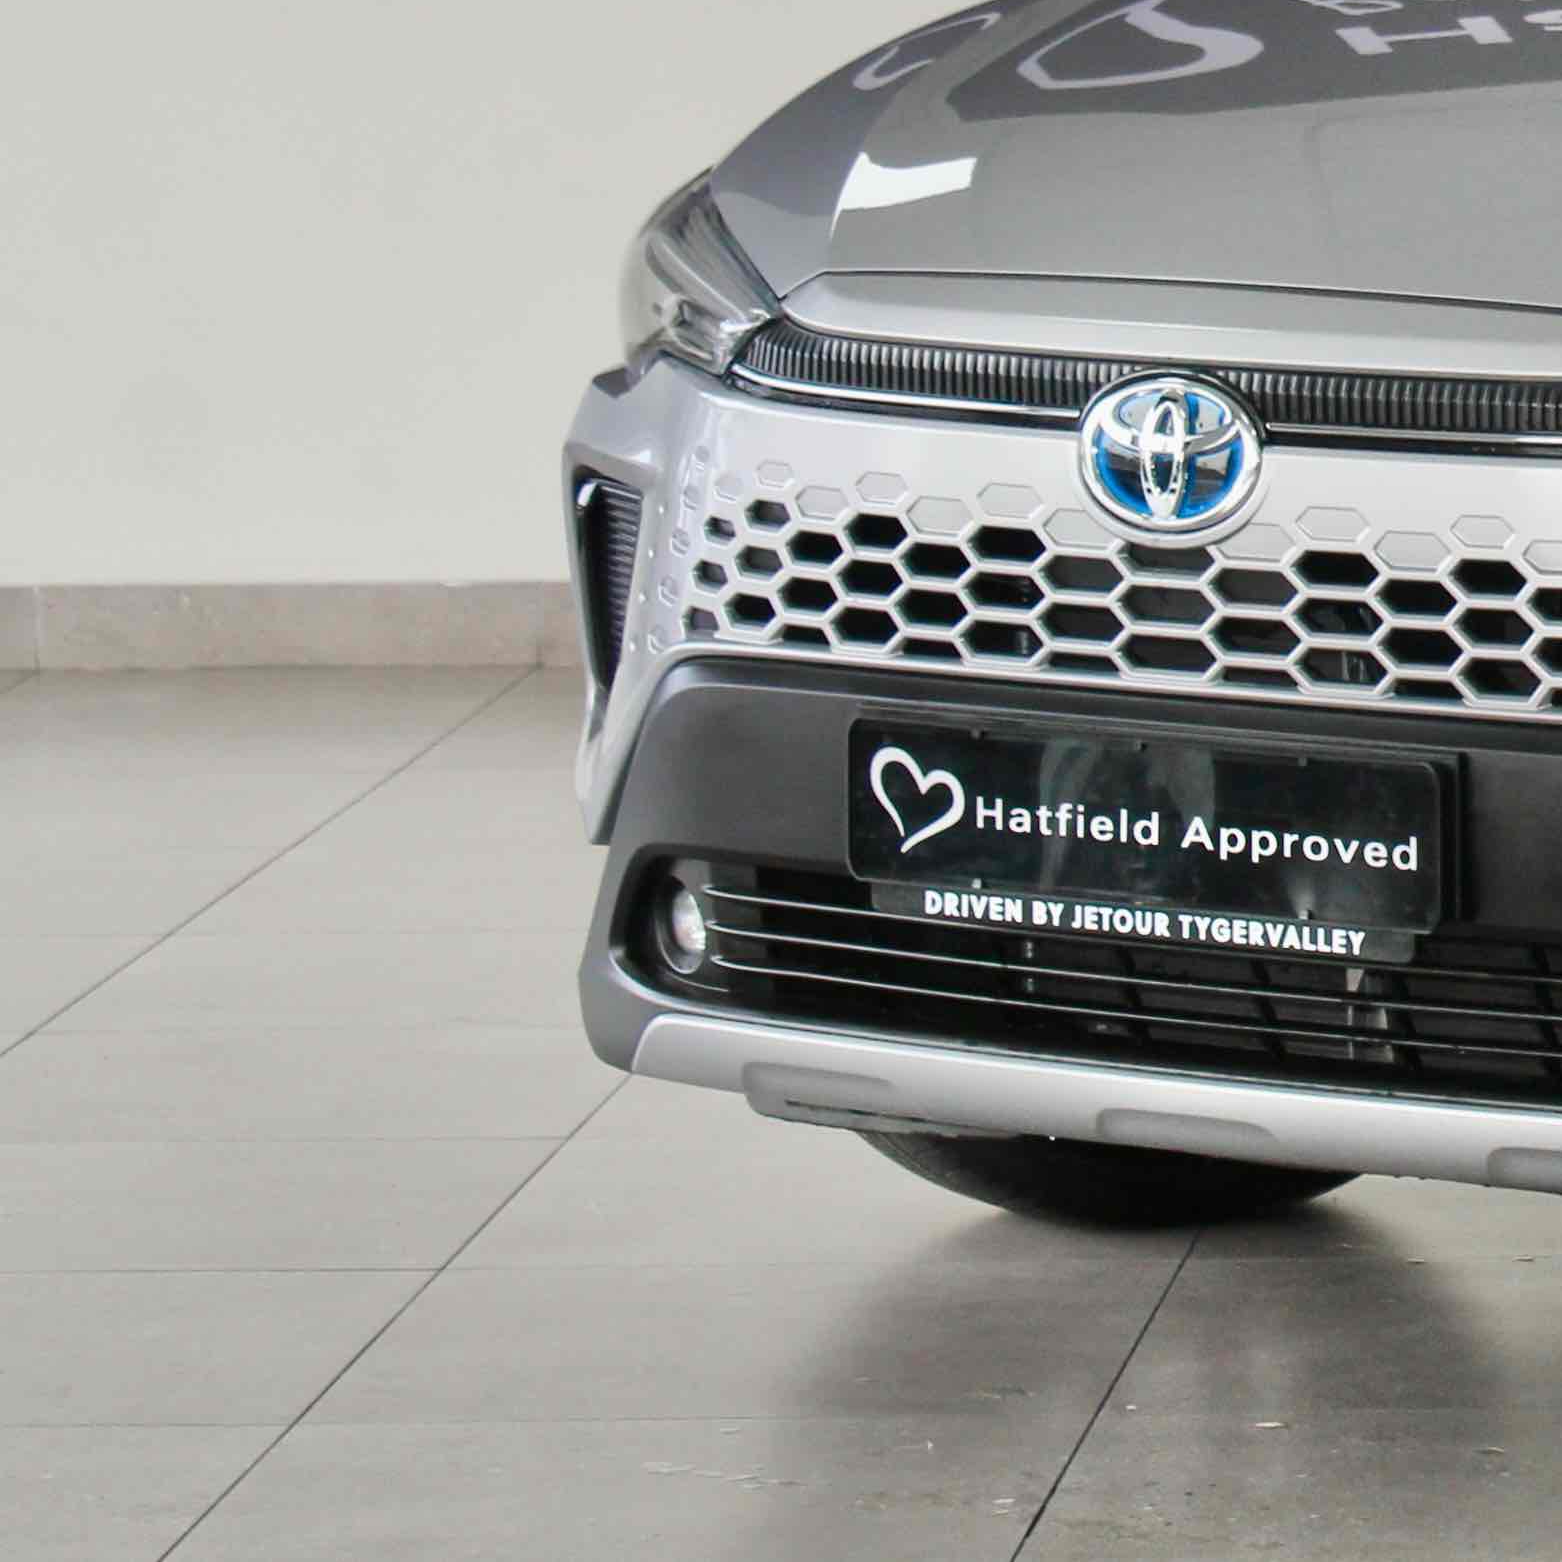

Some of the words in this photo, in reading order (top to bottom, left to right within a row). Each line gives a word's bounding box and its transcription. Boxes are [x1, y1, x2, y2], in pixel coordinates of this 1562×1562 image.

[975, 794, 1161, 846] Hatfield
[1179, 814, 1419, 872] Approved
[923, 889, 1024, 925] DRIVEN
[1030, 898, 1067, 928] BY
[1071, 903, 1172, 939] JETOUR
[1177, 913, 1366, 957] TYGERVALLEY
